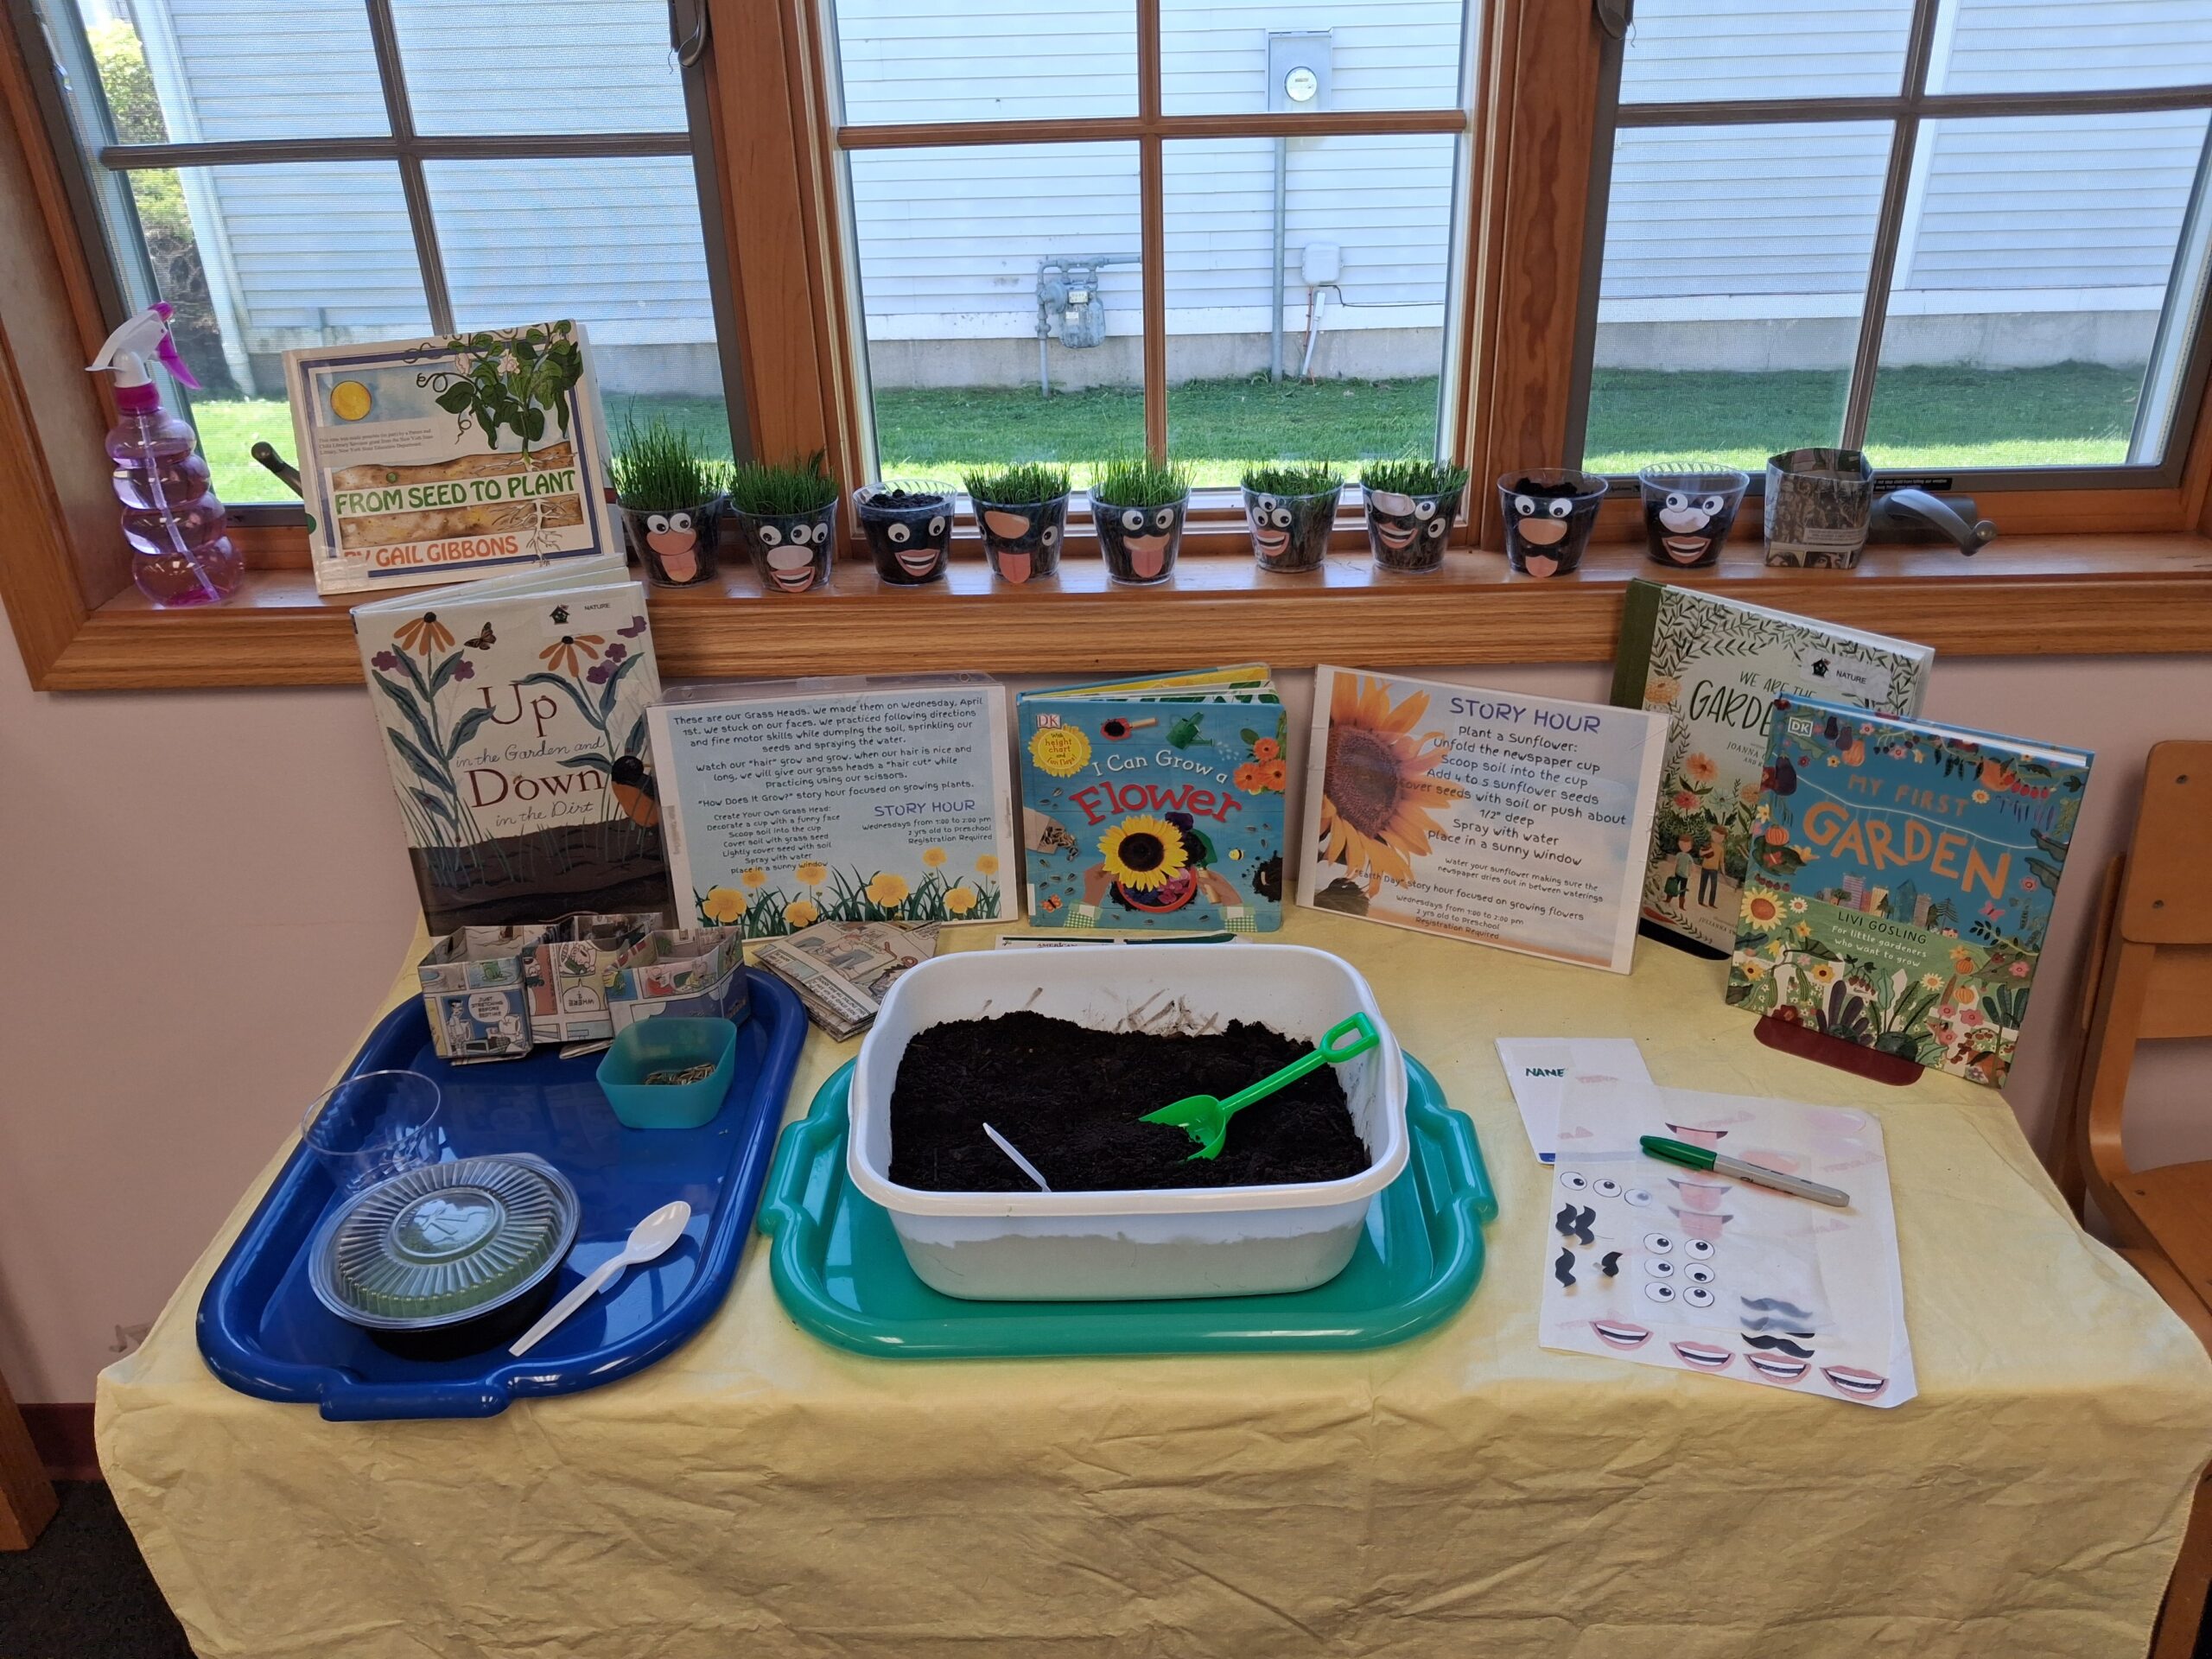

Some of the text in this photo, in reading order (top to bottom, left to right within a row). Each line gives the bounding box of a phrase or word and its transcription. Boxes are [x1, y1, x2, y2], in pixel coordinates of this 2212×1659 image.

[335, 470, 575, 515] FROM SEED TO PLANT
[375, 546, 424, 567] GAIL
[426, 535, 518, 562] GIBBONS
[585, 603, 610, 611] NATURE
[1740, 671, 1760, 687] WE
[1764, 678, 1789, 694] ARE
[1836, 670, 1867, 684] NATURE
[477, 683, 557, 738] Up
[673, 715, 703, 725] These
[725, 713, 744, 721] our
[744, 711, 774, 719] Grass
[776, 707, 810, 718] Heads.
[812, 707, 827, 715] We
[830, 704, 858, 713] made
[859, 702, 885, 712] them
[959, 696, 983, 708] April
[682, 727, 702, 736] 1st.
[703, 726, 718, 734] We
[721, 722, 750, 733] stuck
[766, 722, 783, 730] our
[785, 718, 817, 730] faces.
[836, 713, 881, 727] practiced
[884, 711, 927, 723] following
[929, 709, 976, 719] directions
[1039, 715, 1058, 727] DK
[1450, 698, 1600, 734] STORY HOUR
[1690, 679, 1773, 737] GARDE
[690, 738, 708, 747] and
[711, 735, 731, 747] fine
[733, 734, 764, 744] motor
[766, 731, 793, 741] skills
[795, 729, 820, 740] while
[822, 726, 865, 741] dumping
[866, 724, 882, 734] the
[884, 723, 906, 733] soil,
[908, 720, 955, 733] sprinkling
[1458, 725, 1578, 752] Plant a Sunflower:
[1791, 721, 1809, 733] DK
[456, 737, 606, 768] in the Garden and
[762, 735, 906, 753] seeds and spraying the water.
[1433, 738, 1601, 776] Unfold the newspaper cup
[1726, 742, 1759, 758] JOANNA
[1092, 750, 1228, 784] I Can Grow a
[1440, 754, 1588, 790] Scoop soil into the cup
[1743, 757, 1756, 766] AND
[463, 769, 606, 808] Down
[725, 797, 749, 805] Does
[751, 794, 759, 803] It
[761, 792, 793, 802] Grow?"
[796, 791, 822, 801] story
[824, 788, 847, 797] hour
[848, 785, 887, 797] focused
[903, 782, 938, 794] growing
[942, 780, 974, 790] plants.
[1426, 768, 1599, 805] Add 4 to 5 sunflower seeds
[1848, 774, 1968, 817] MY FIRST
[496, 801, 594, 827] in the Dirt
[874, 799, 975, 817] STORY HOUR
[1068, 781, 1242, 826] Flower
[1436, 786, 1471, 799] seeds
[1475, 792, 1502, 805] with
[1505, 797, 1530, 809] soil
[1533, 803, 1548, 813] or
[1550, 806, 1583, 818] push
[1587, 810, 1627, 825] about
[1452, 818, 1560, 846] Spray with water
[1479, 809, 1535, 830] 1/2" deep
[1427, 829, 1582, 866] Place in a sunny window
[1803, 801, 2012, 900] GARDEN
[1408, 880, 1431, 893] story
[1433, 883, 1454, 895] hour
[1456, 888, 1494, 904] focused
[1509, 901, 1546, 916] growing
[1546, 906, 1584, 921] flowers
[1831, 925, 1927, 958] For little gardeners
[1838, 912, 1927, 944] LIVI GOSLING
[1835, 938, 1921, 968] who want to grow
